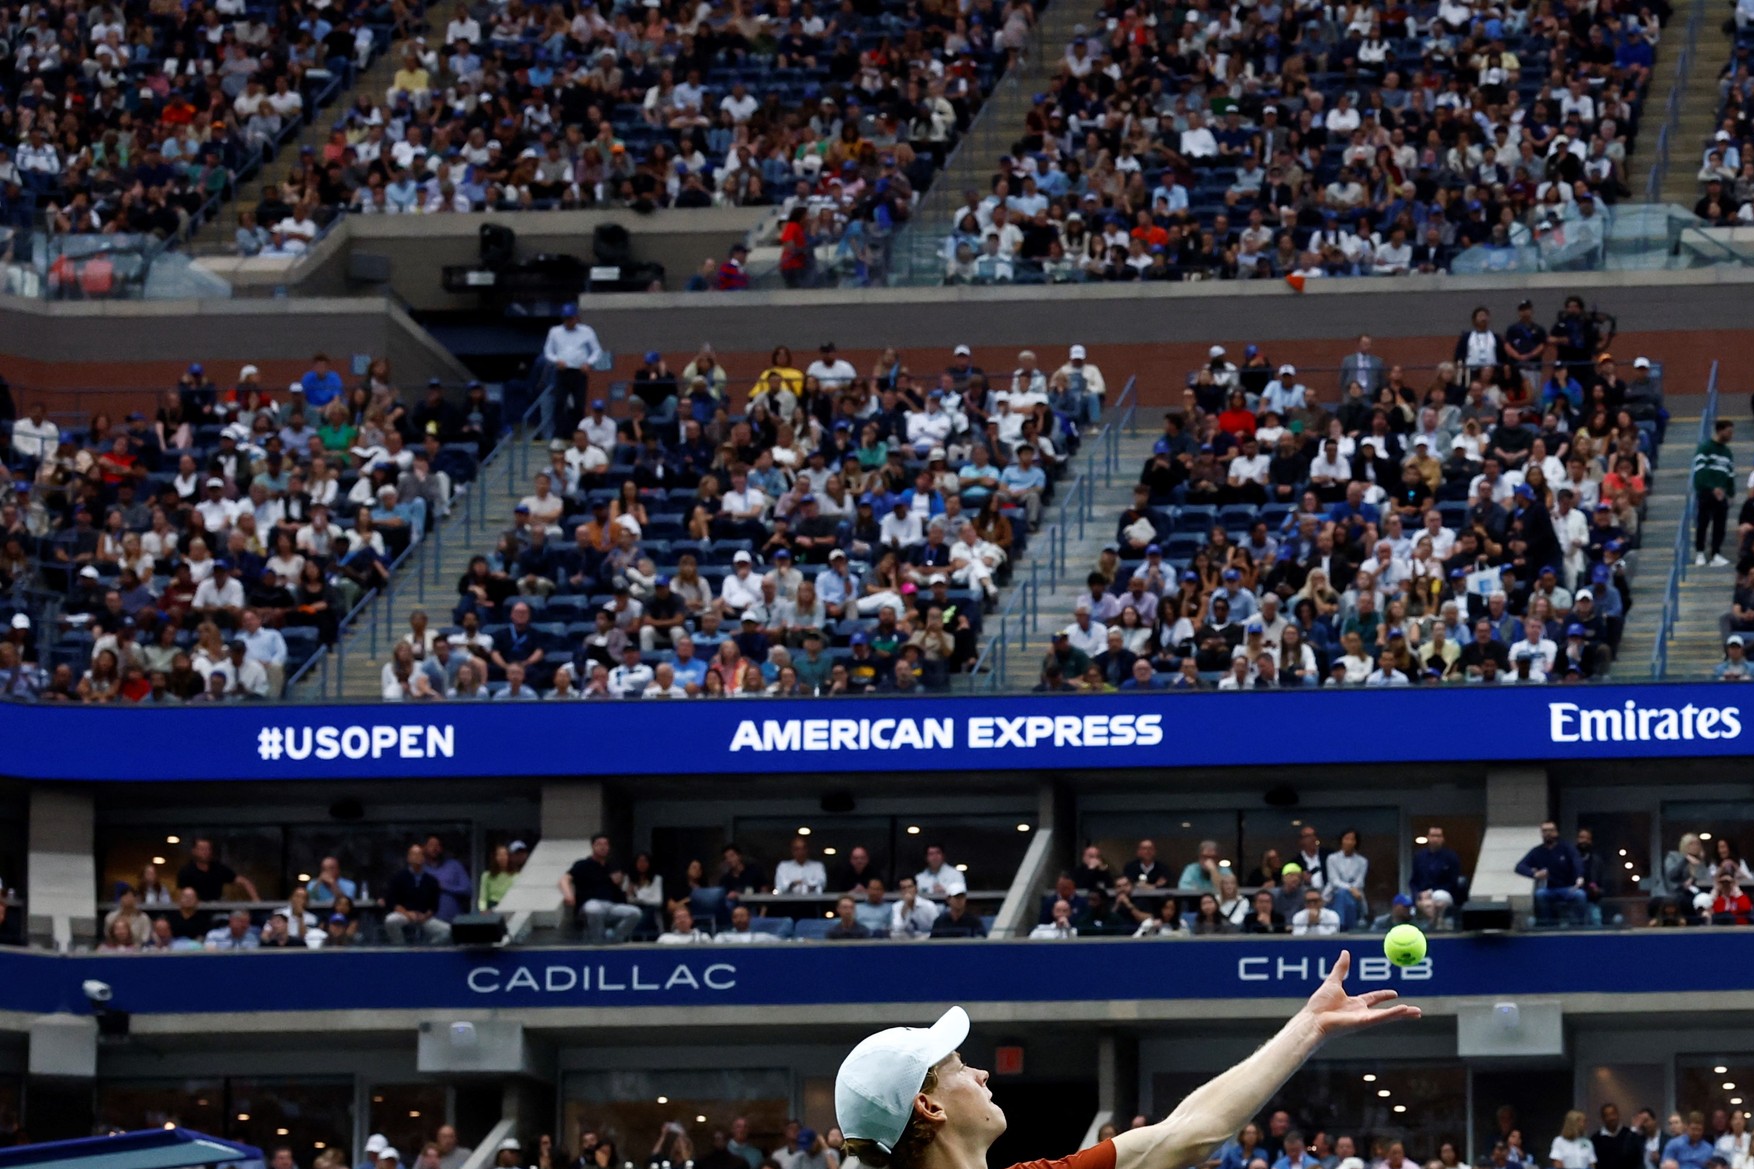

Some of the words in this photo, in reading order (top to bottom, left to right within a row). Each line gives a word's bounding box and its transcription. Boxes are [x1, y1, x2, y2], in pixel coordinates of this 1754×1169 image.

[730, 717, 954, 752] AMERICAN
[967, 714, 1163, 749] EXPRESS
[1548, 700, 1742, 742] Emirates
[257, 724, 454, 760] #USOPEN
[467, 963, 737, 993] CADILLAC
